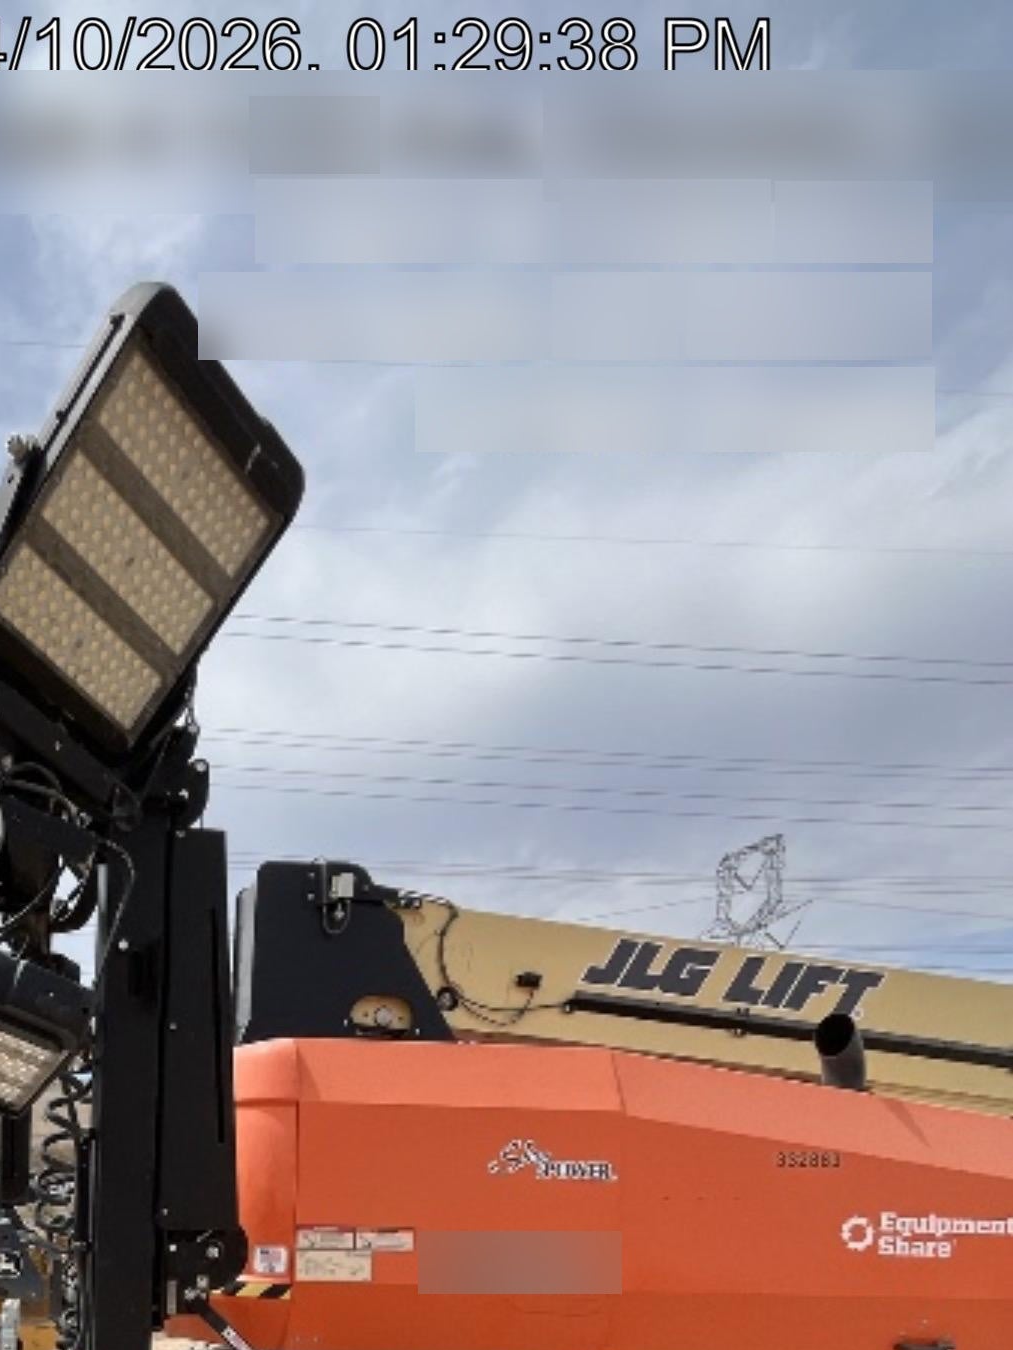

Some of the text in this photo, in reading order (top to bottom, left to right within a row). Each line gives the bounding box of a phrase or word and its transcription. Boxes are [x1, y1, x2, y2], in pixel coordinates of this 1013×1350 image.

[581, 938, 886, 1016] JLG LIFT
[879, 1211, 1013, 1236] Equipment
[878, 1236, 952, 1258] Share
